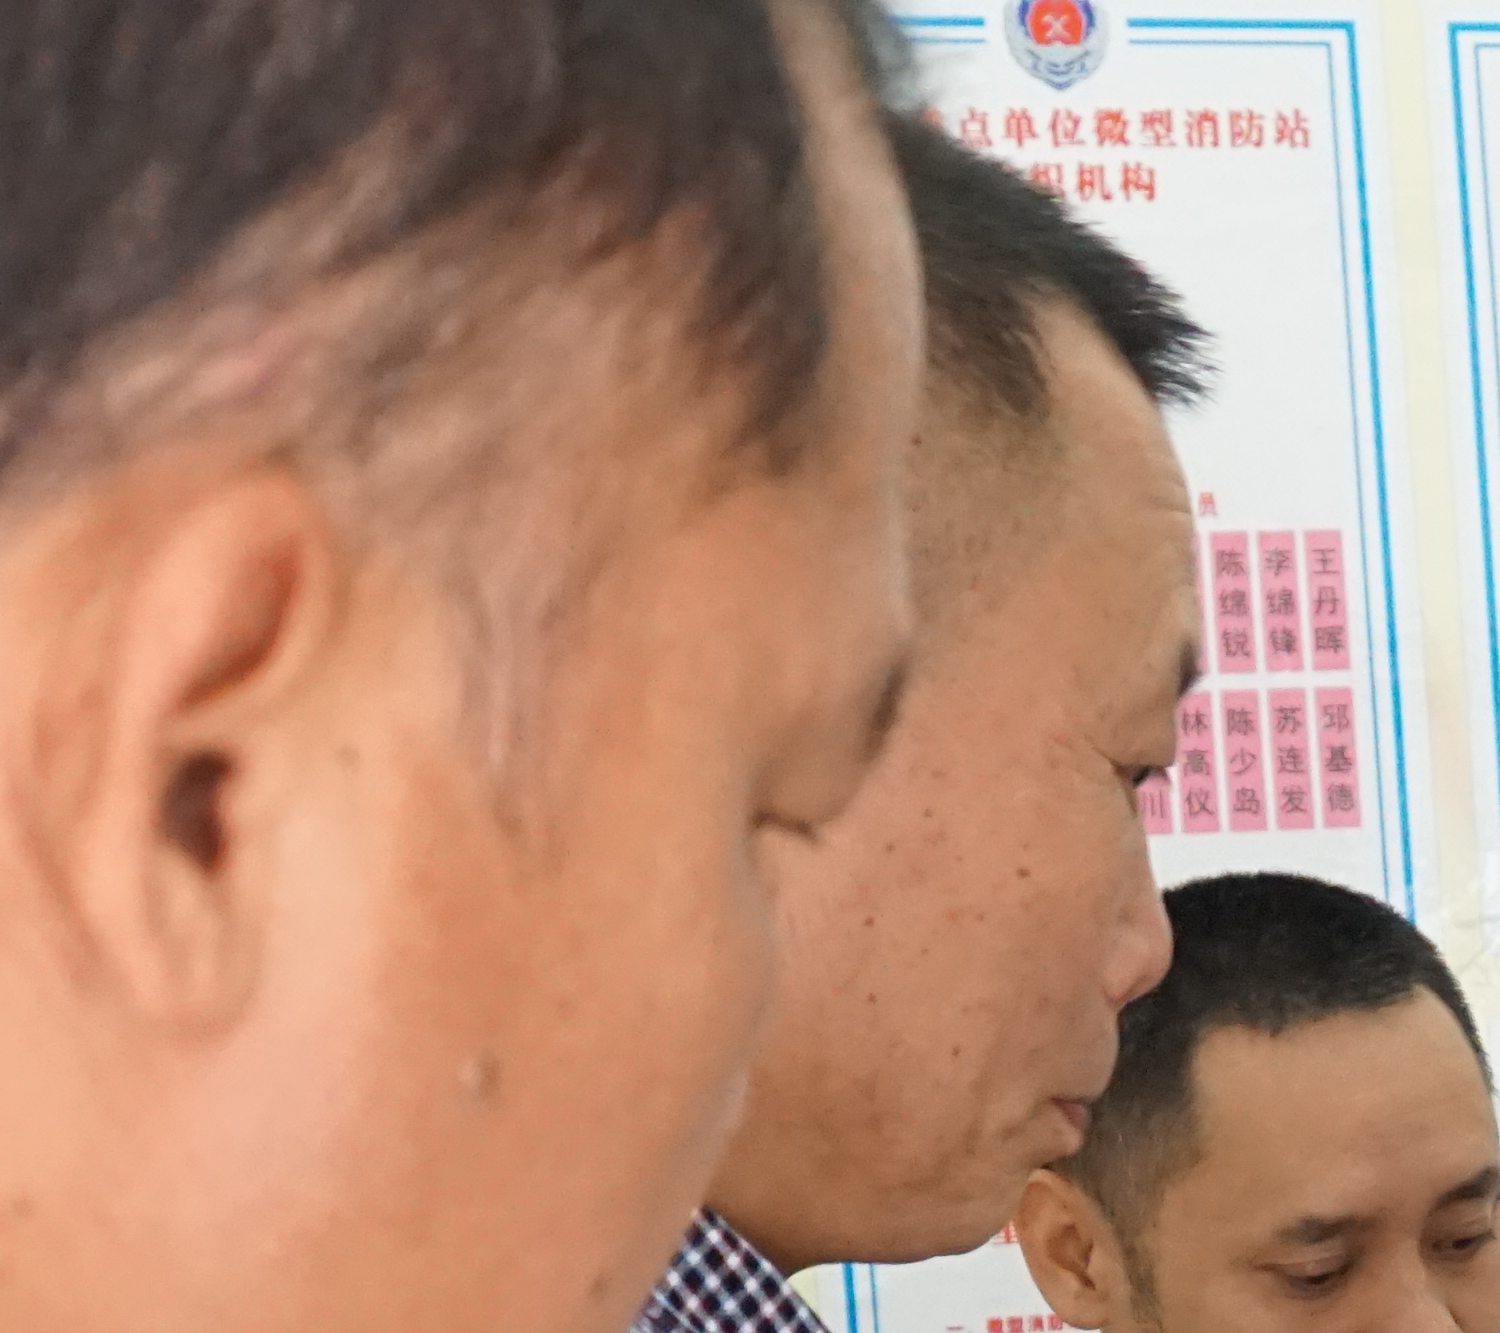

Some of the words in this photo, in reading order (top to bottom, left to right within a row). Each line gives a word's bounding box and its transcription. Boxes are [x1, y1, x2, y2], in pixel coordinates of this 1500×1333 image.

[926, 108, 1312, 150] 点单位微型消防站
[1004, 160, 1158, 202] 织机构
